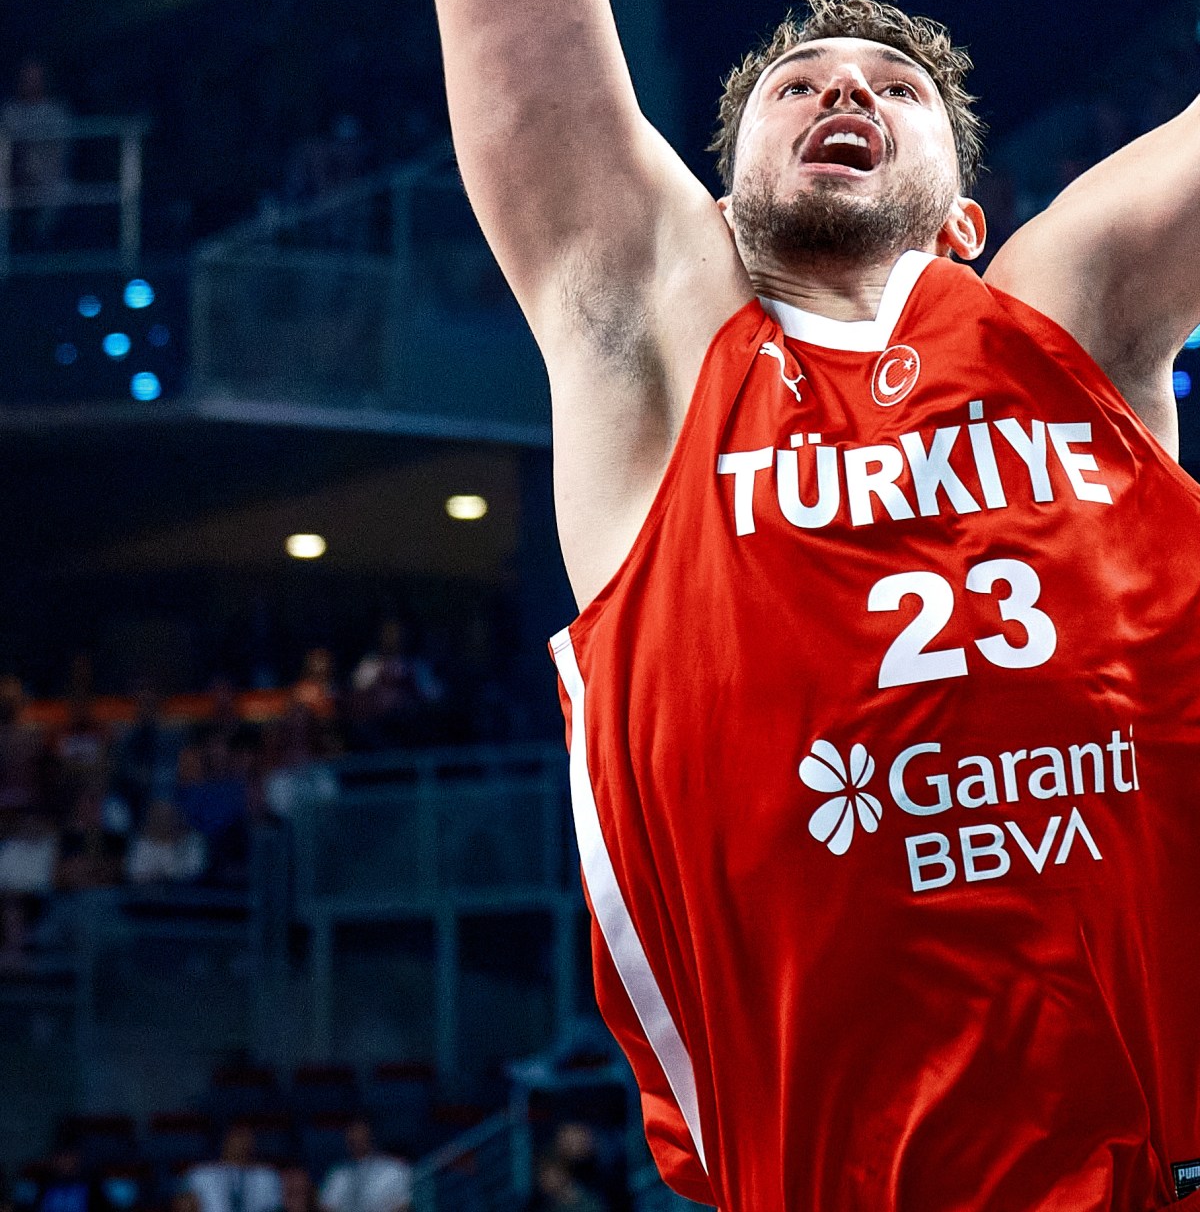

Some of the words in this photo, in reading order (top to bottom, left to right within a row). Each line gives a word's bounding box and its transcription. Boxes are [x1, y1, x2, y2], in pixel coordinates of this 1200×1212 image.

[717, 400, 1113, 536] TÜRKİYE
[867, 558, 1058, 689] 23
[888, 724, 1140, 816] Garanti
[904, 806, 1103, 892] BBVA
